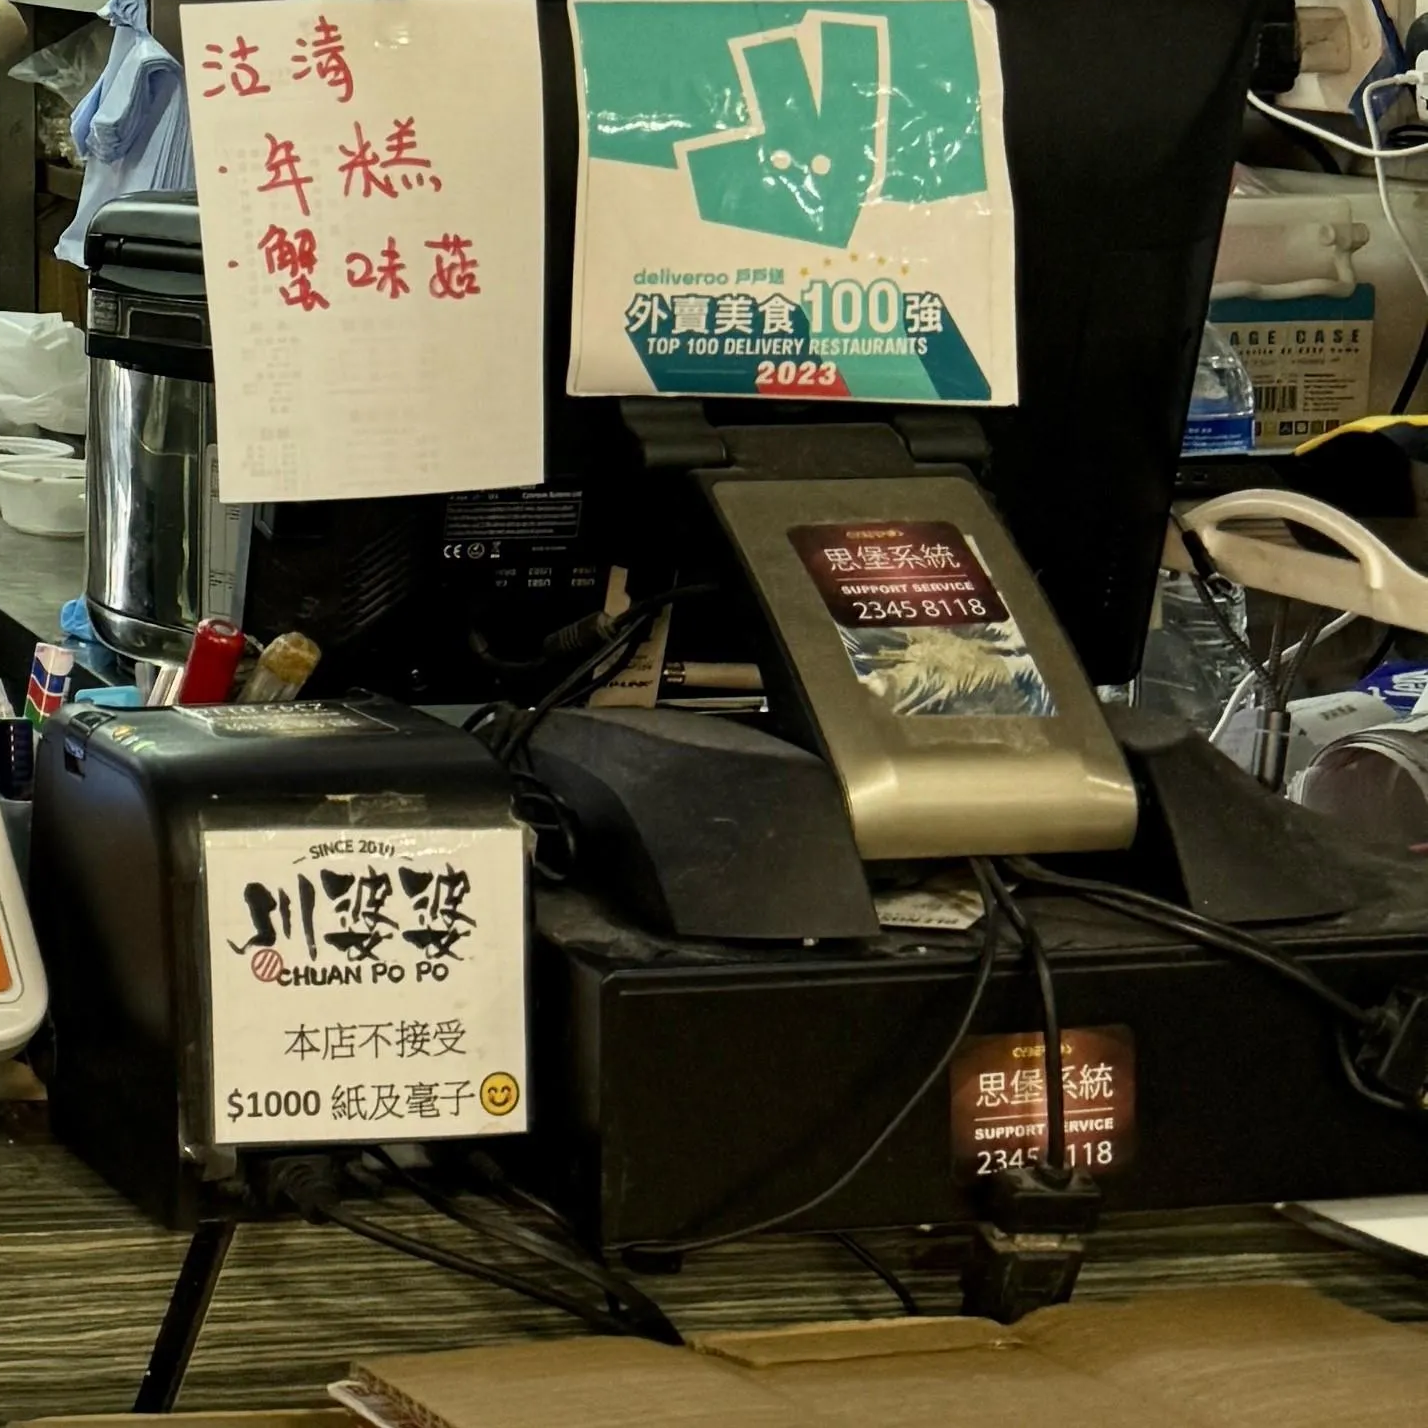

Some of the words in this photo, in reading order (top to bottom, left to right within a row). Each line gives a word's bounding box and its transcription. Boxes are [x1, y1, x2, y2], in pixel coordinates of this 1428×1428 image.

[633, 268, 728, 286] deliveroo
[647, 338, 679, 355] TOP
[687, 337, 719, 355] 100
[724, 338, 803, 355] DELIVERY
[810, 337, 928, 355] RESTAURANTS
[755, 361, 836, 385] 2023
[841, 582, 909, 595] SUPPORT
[913, 580, 974, 593] SERVICE
[852, 599, 918, 620] 2345
[923, 596, 986, 618] 8118
[308, 840, 354, 859] SINCE
[227, 863, 476, 961] 川婆婆
[277, 966, 362, 987] CHUAN
[371, 963, 405, 983] PO
[415, 961, 449, 982] PO
[284, 1019, 467, 1061] 本店不接受
[226, 1089, 320, 1122] $1000
